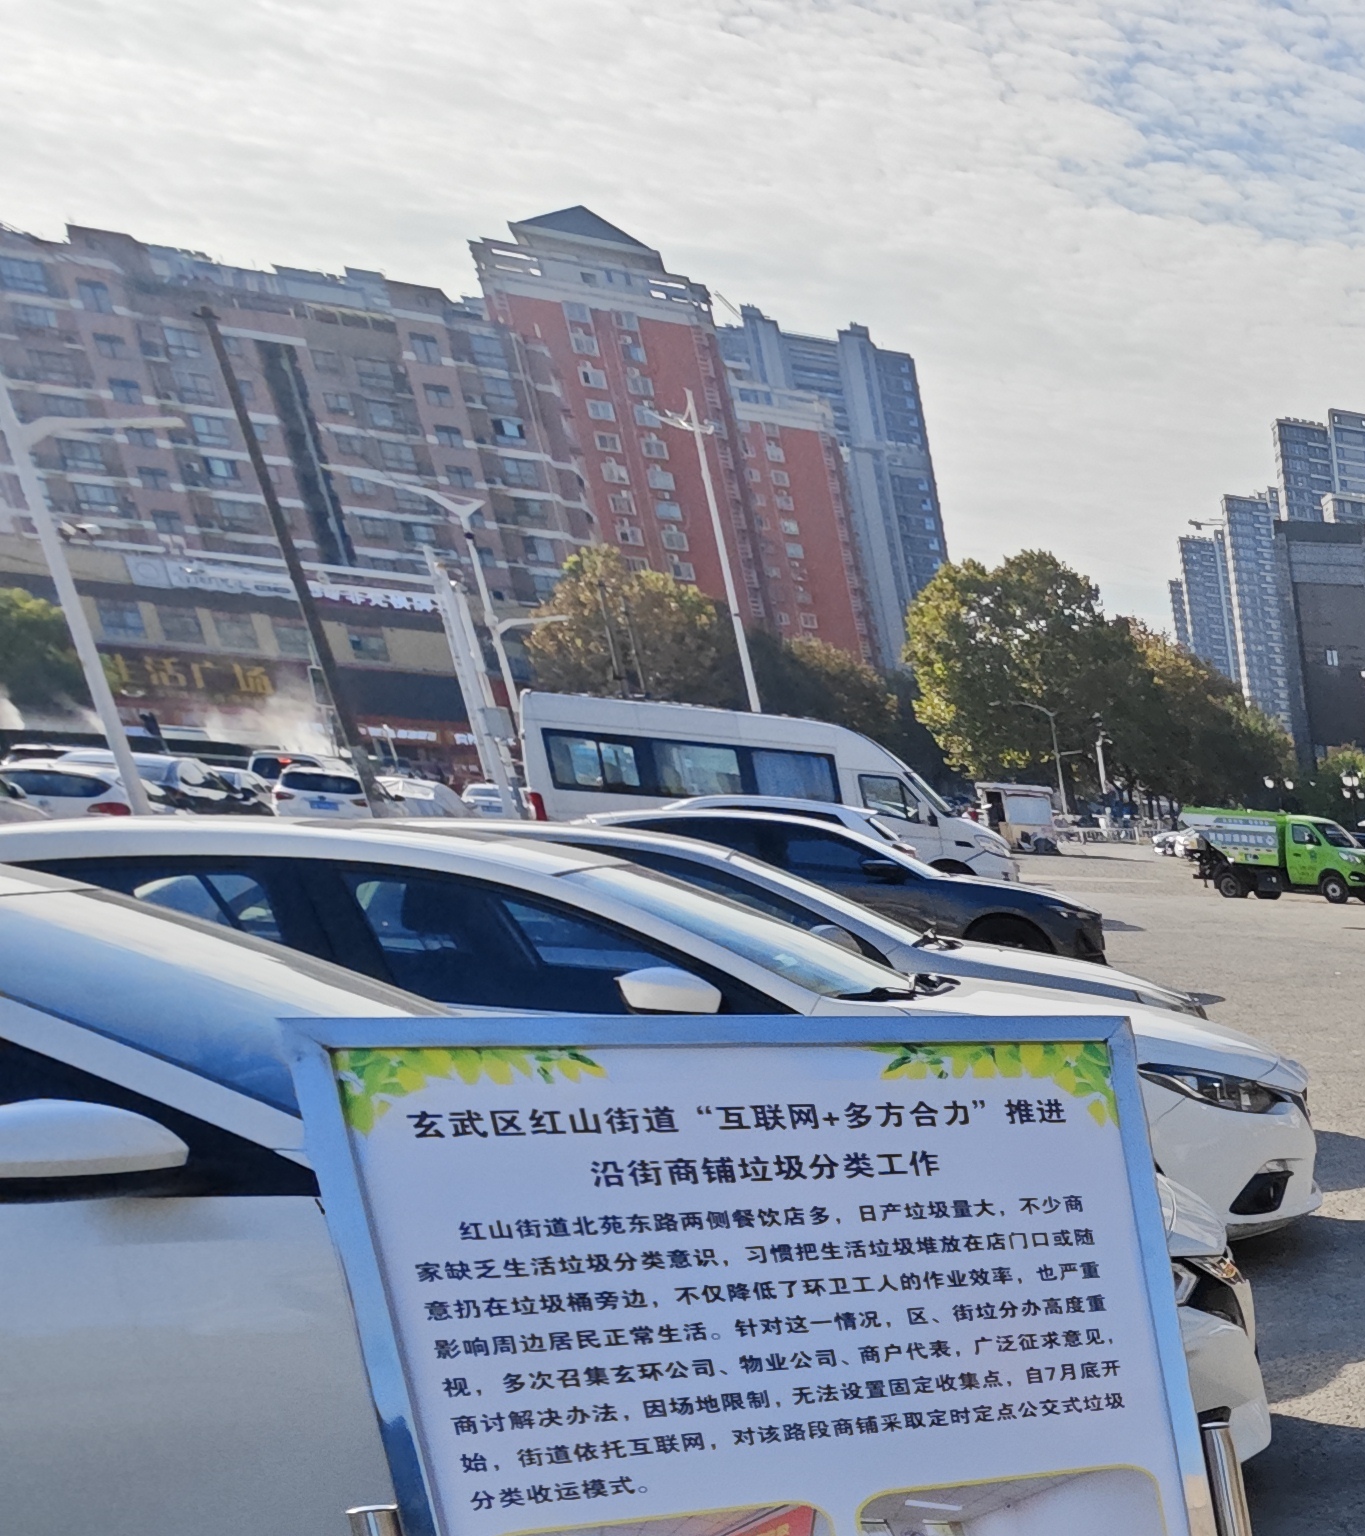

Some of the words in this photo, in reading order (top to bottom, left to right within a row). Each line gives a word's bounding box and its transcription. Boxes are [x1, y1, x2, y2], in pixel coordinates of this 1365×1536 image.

[590, 1149, 941, 1188] 沿街商铺垃圾分类工作
[458, 1193, 1085, 1241] 红山街道北苑东路两侧餐饮店多，日产垃圾量大，不少商
[414, 1227, 1096, 1283] 家缺乏生活垃圾分类意识，习惯把生活垃圾堆放在店门口或随
[423, 1260, 1102, 1322] 意扔在垃圾桶旁边，不仅降低了环卫工人的作业效率，也严重
[433, 1293, 1108, 1360] 影响周边居民正常生活。针对这一情况，区、街垃分办高度重
[441, 1327, 1114, 1398] 视，多次召集玄环公司、物业公司、商户代表，广泛征求意见，
[450, 1359, 1122, 1436] 商讨解决办法，因场地限制，无法设置固定收集点，自7月底开
[459, 1391, 1126, 1474] 始，街道依托互联网，对该路段商铺采取定时定点公交式垃圾
[470, 1475, 648, 1511] 分类收运模式。
